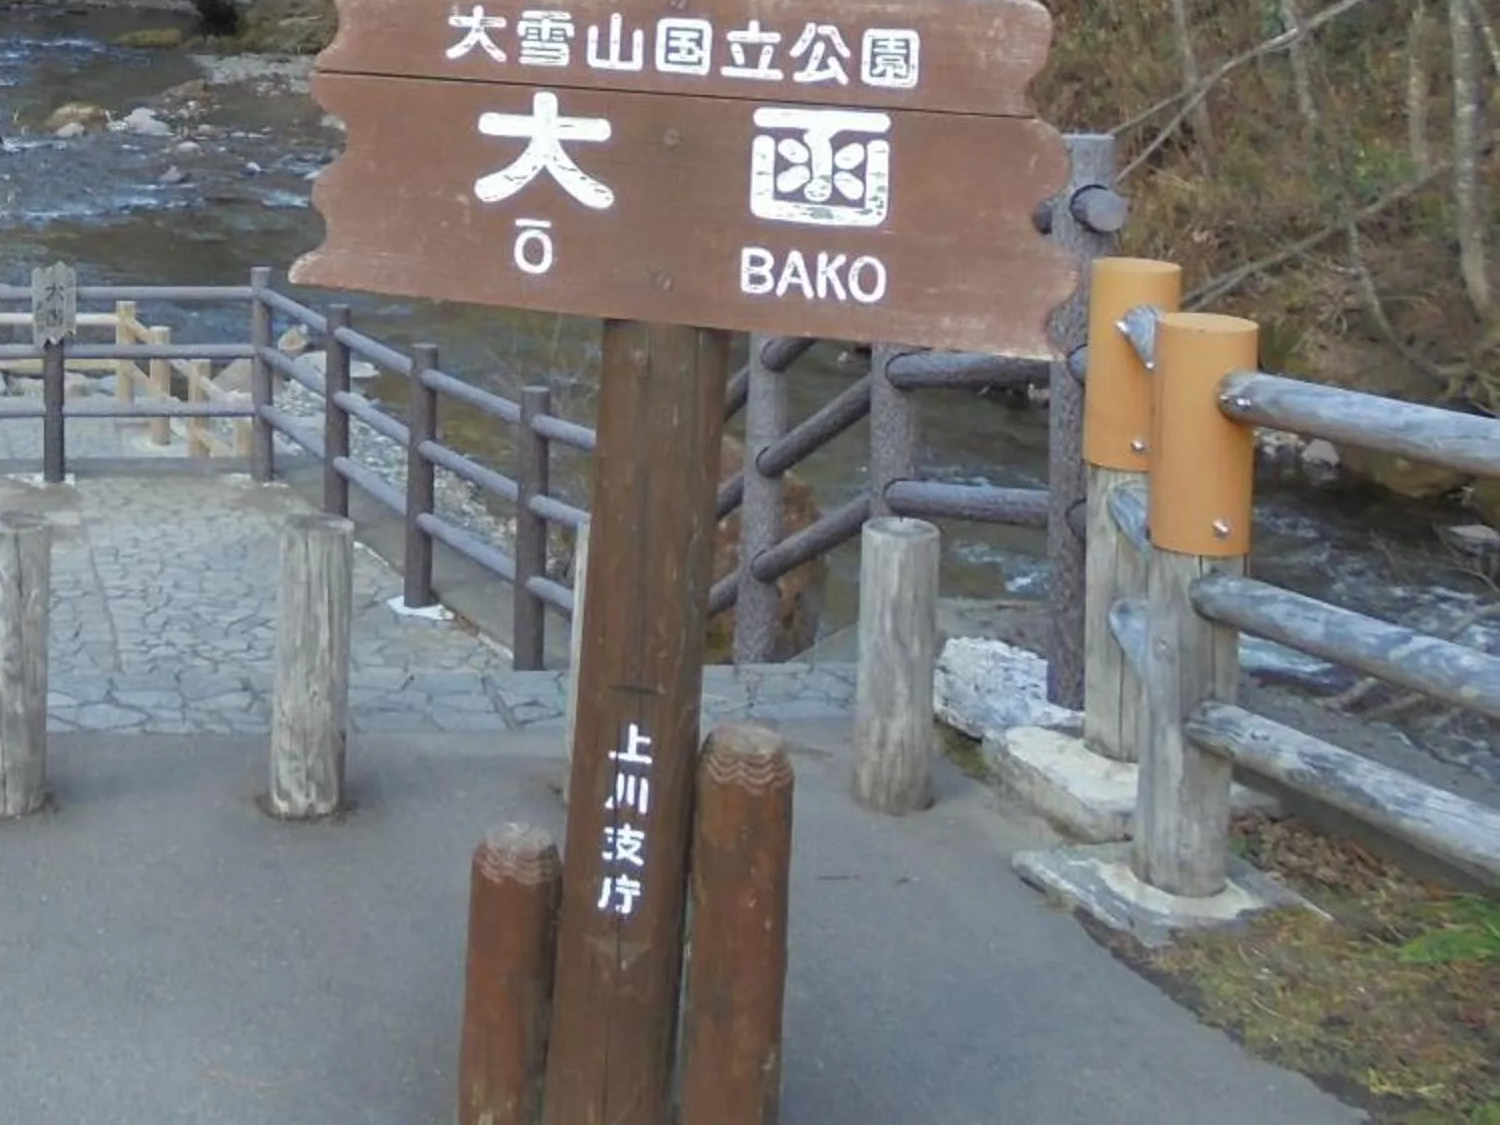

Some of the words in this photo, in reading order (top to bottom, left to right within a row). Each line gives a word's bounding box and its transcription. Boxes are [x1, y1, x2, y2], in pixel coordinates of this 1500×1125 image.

[446, 5, 921, 88] 大雪山国立公園
[740, 247, 887, 305] BAKO
[598, 724, 652, 914] 上川支庁
